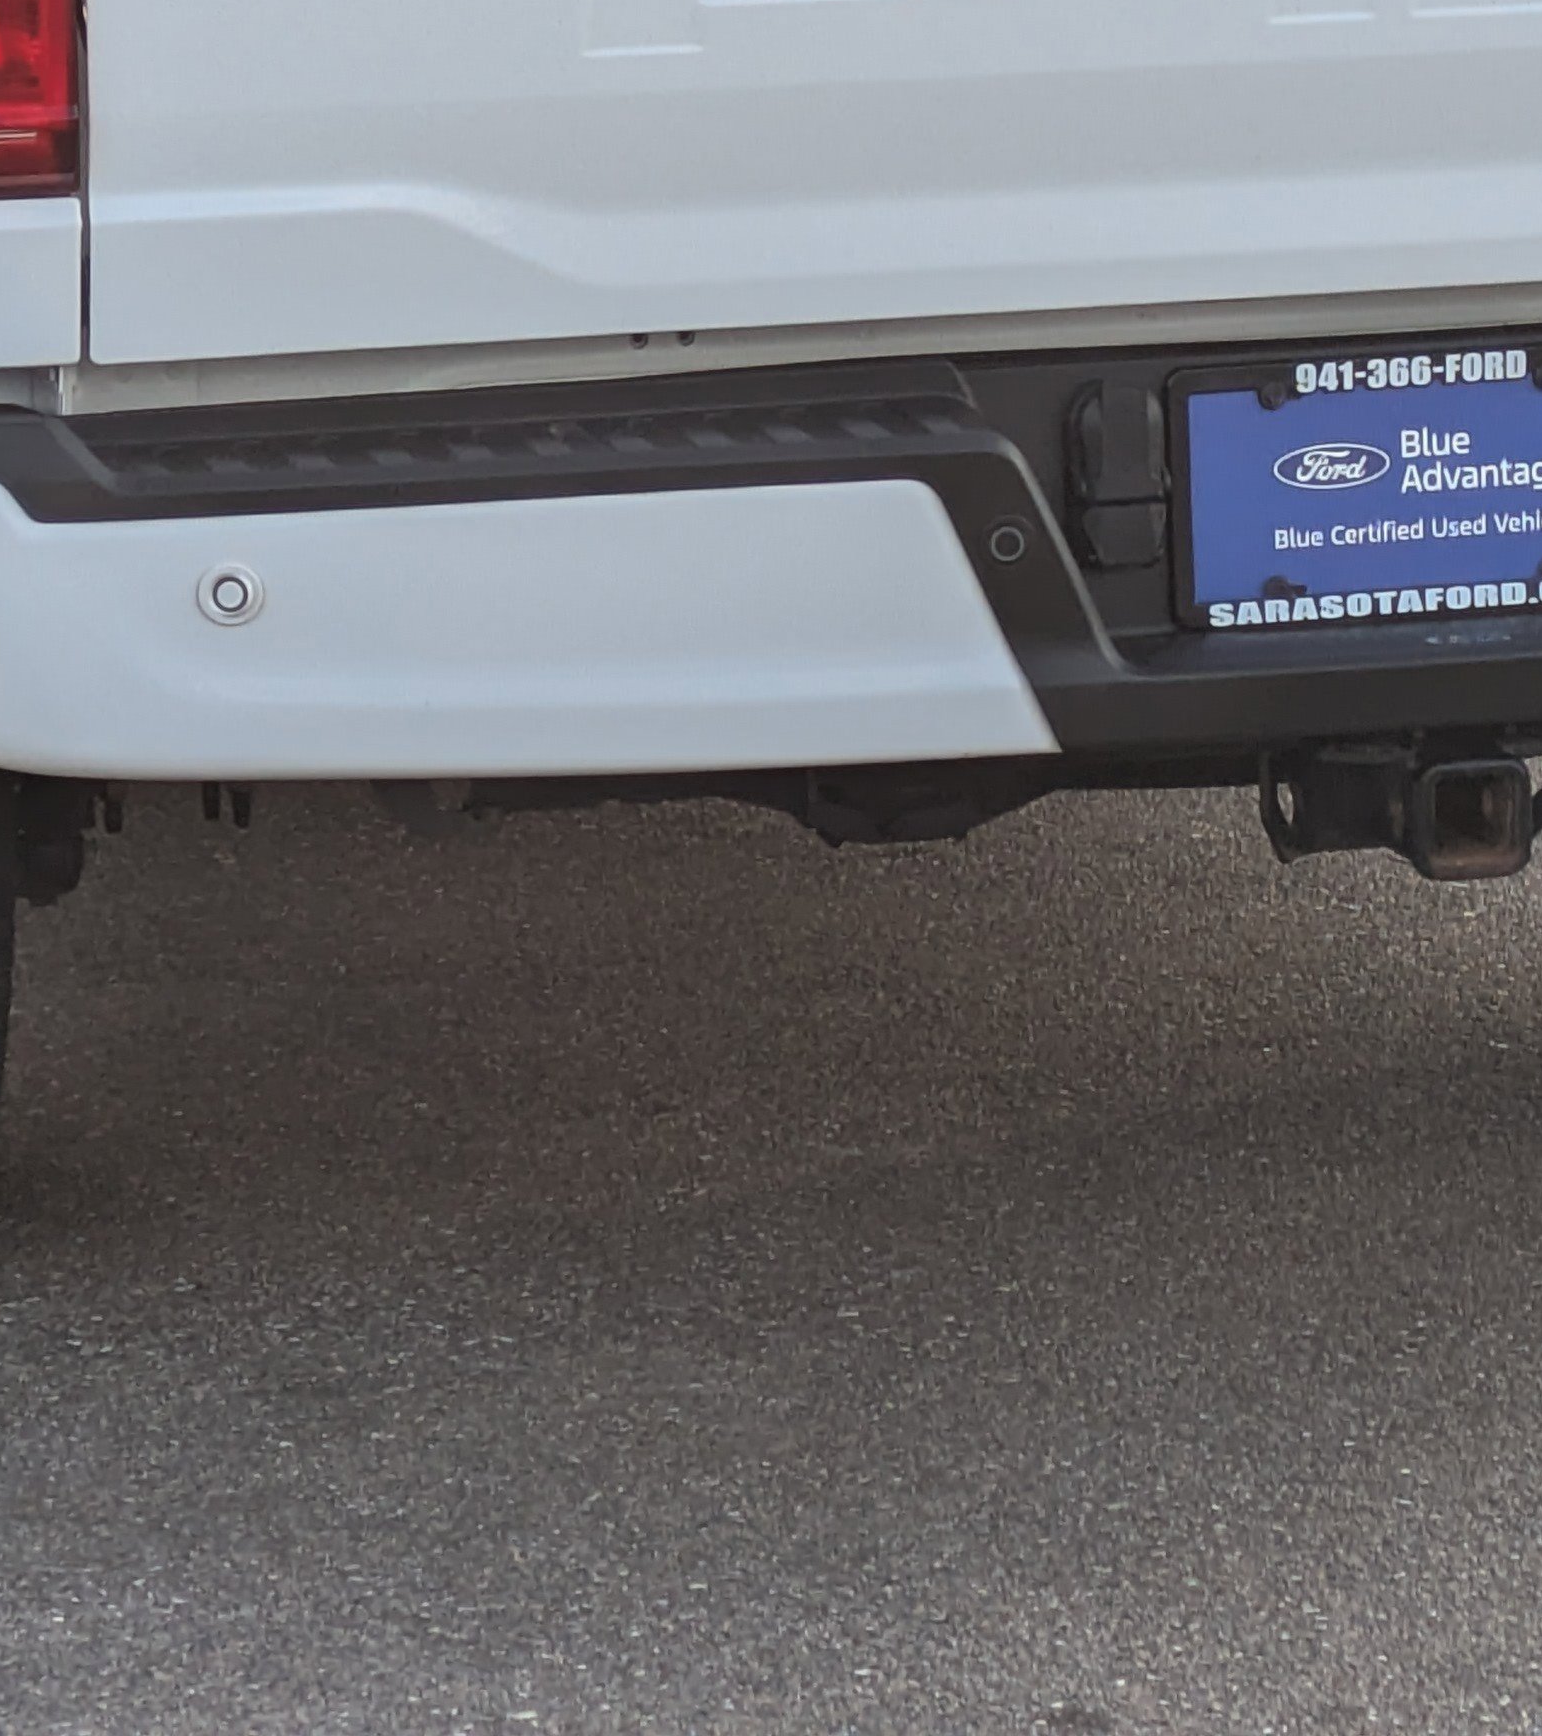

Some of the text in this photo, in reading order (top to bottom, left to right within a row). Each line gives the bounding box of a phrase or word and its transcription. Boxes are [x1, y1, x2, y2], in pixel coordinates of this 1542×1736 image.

[1295, 350, 1527, 395] 941-366-FORD
[1400, 426, 1471, 458] Blue
[1296, 450, 1367, 483] Ford
[1274, 526, 1324, 550] Blue
[1331, 518, 1424, 546] Certified
[1431, 514, 1487, 539] Used
